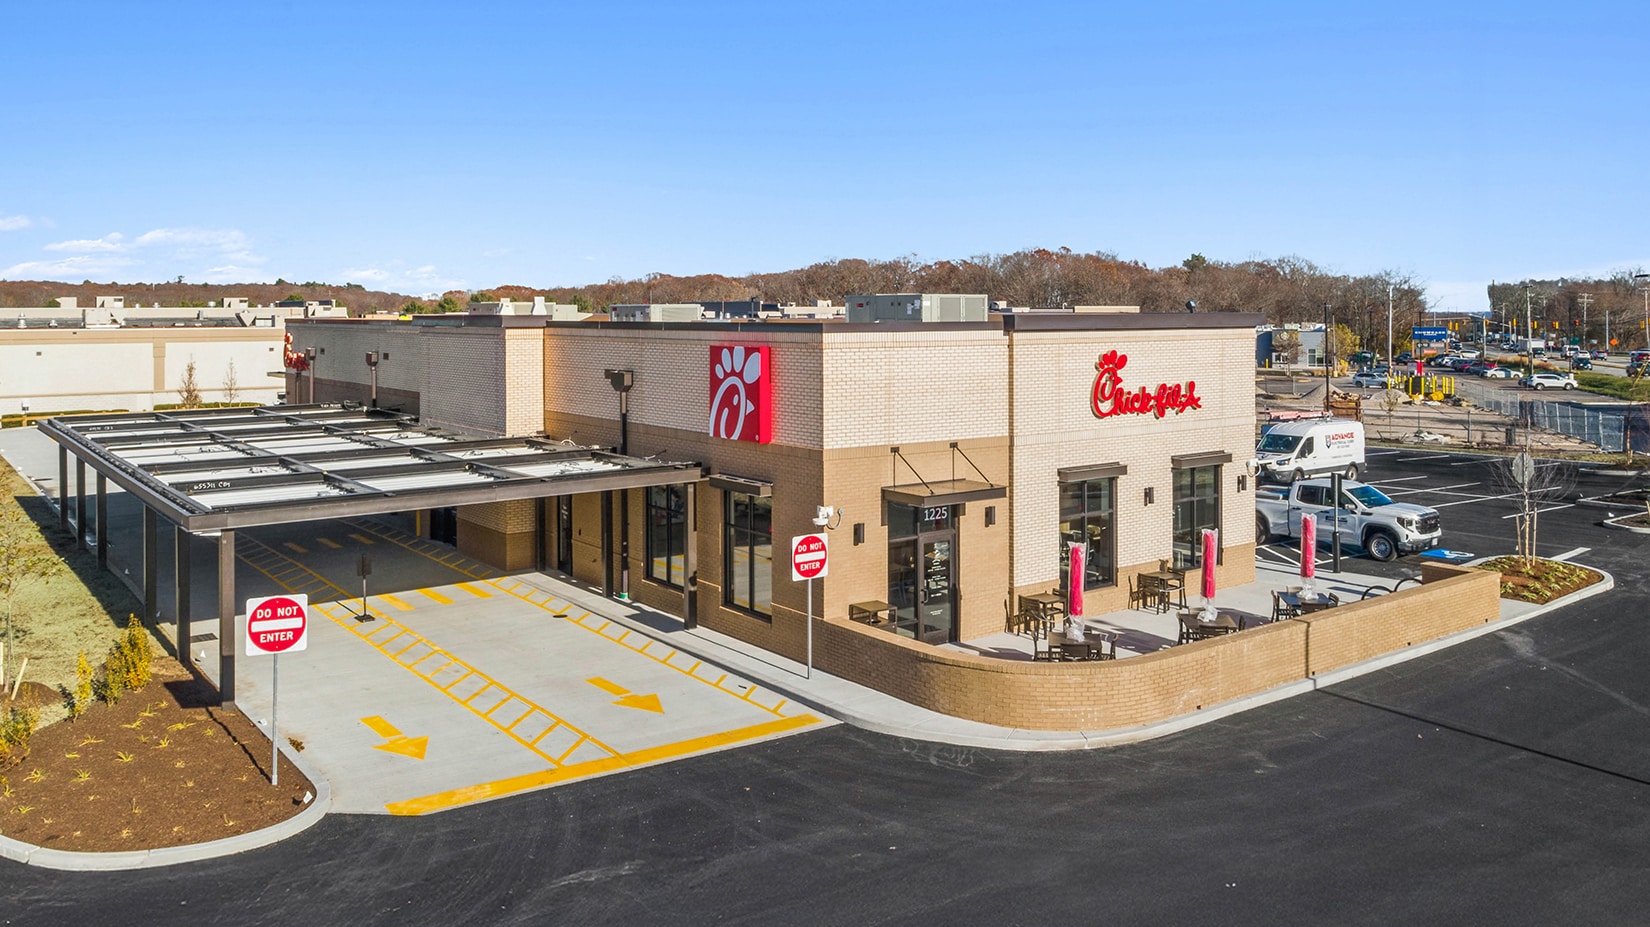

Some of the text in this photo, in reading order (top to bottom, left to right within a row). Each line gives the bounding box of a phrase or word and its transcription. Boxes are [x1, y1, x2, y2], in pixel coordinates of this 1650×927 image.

[1092, 350, 1202, 418] Chick-fil-A
[1331, 432, 1354, 440] ADVANCE
[924, 507, 948, 521] 1225
[798, 542, 822, 552] DO NOT
[800, 562, 820, 571] ENTER
[256, 606, 298, 619] DO NOT
[260, 631, 294, 643] ENTER
